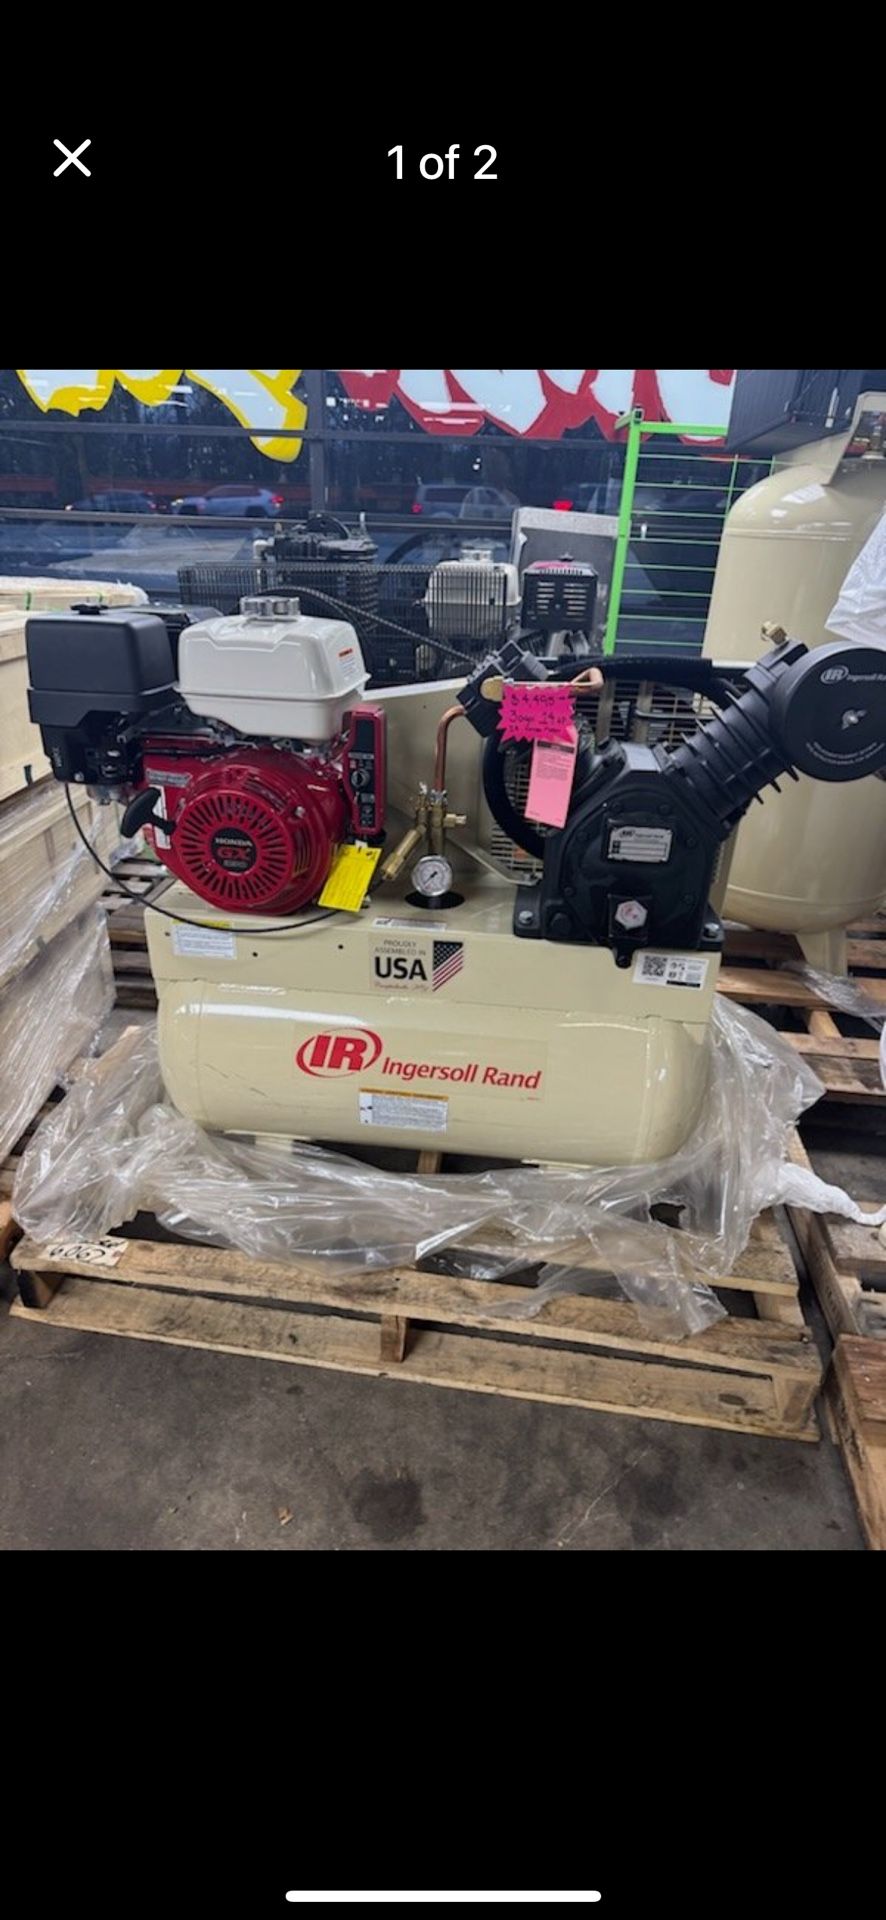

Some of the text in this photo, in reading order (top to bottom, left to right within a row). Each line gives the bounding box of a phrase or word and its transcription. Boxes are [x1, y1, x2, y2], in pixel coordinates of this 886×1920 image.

[214, 837, 253, 848] HONDA
[216, 847, 250, 860] GX
[383, 939, 417, 949] PROUDLY
[375, 947, 427, 958] ASSEMBLED IN
[375, 956, 428, 981] USA
[382, 1057, 479, 1082] Ingersoll
[481, 1066, 542, 1089] Rand
